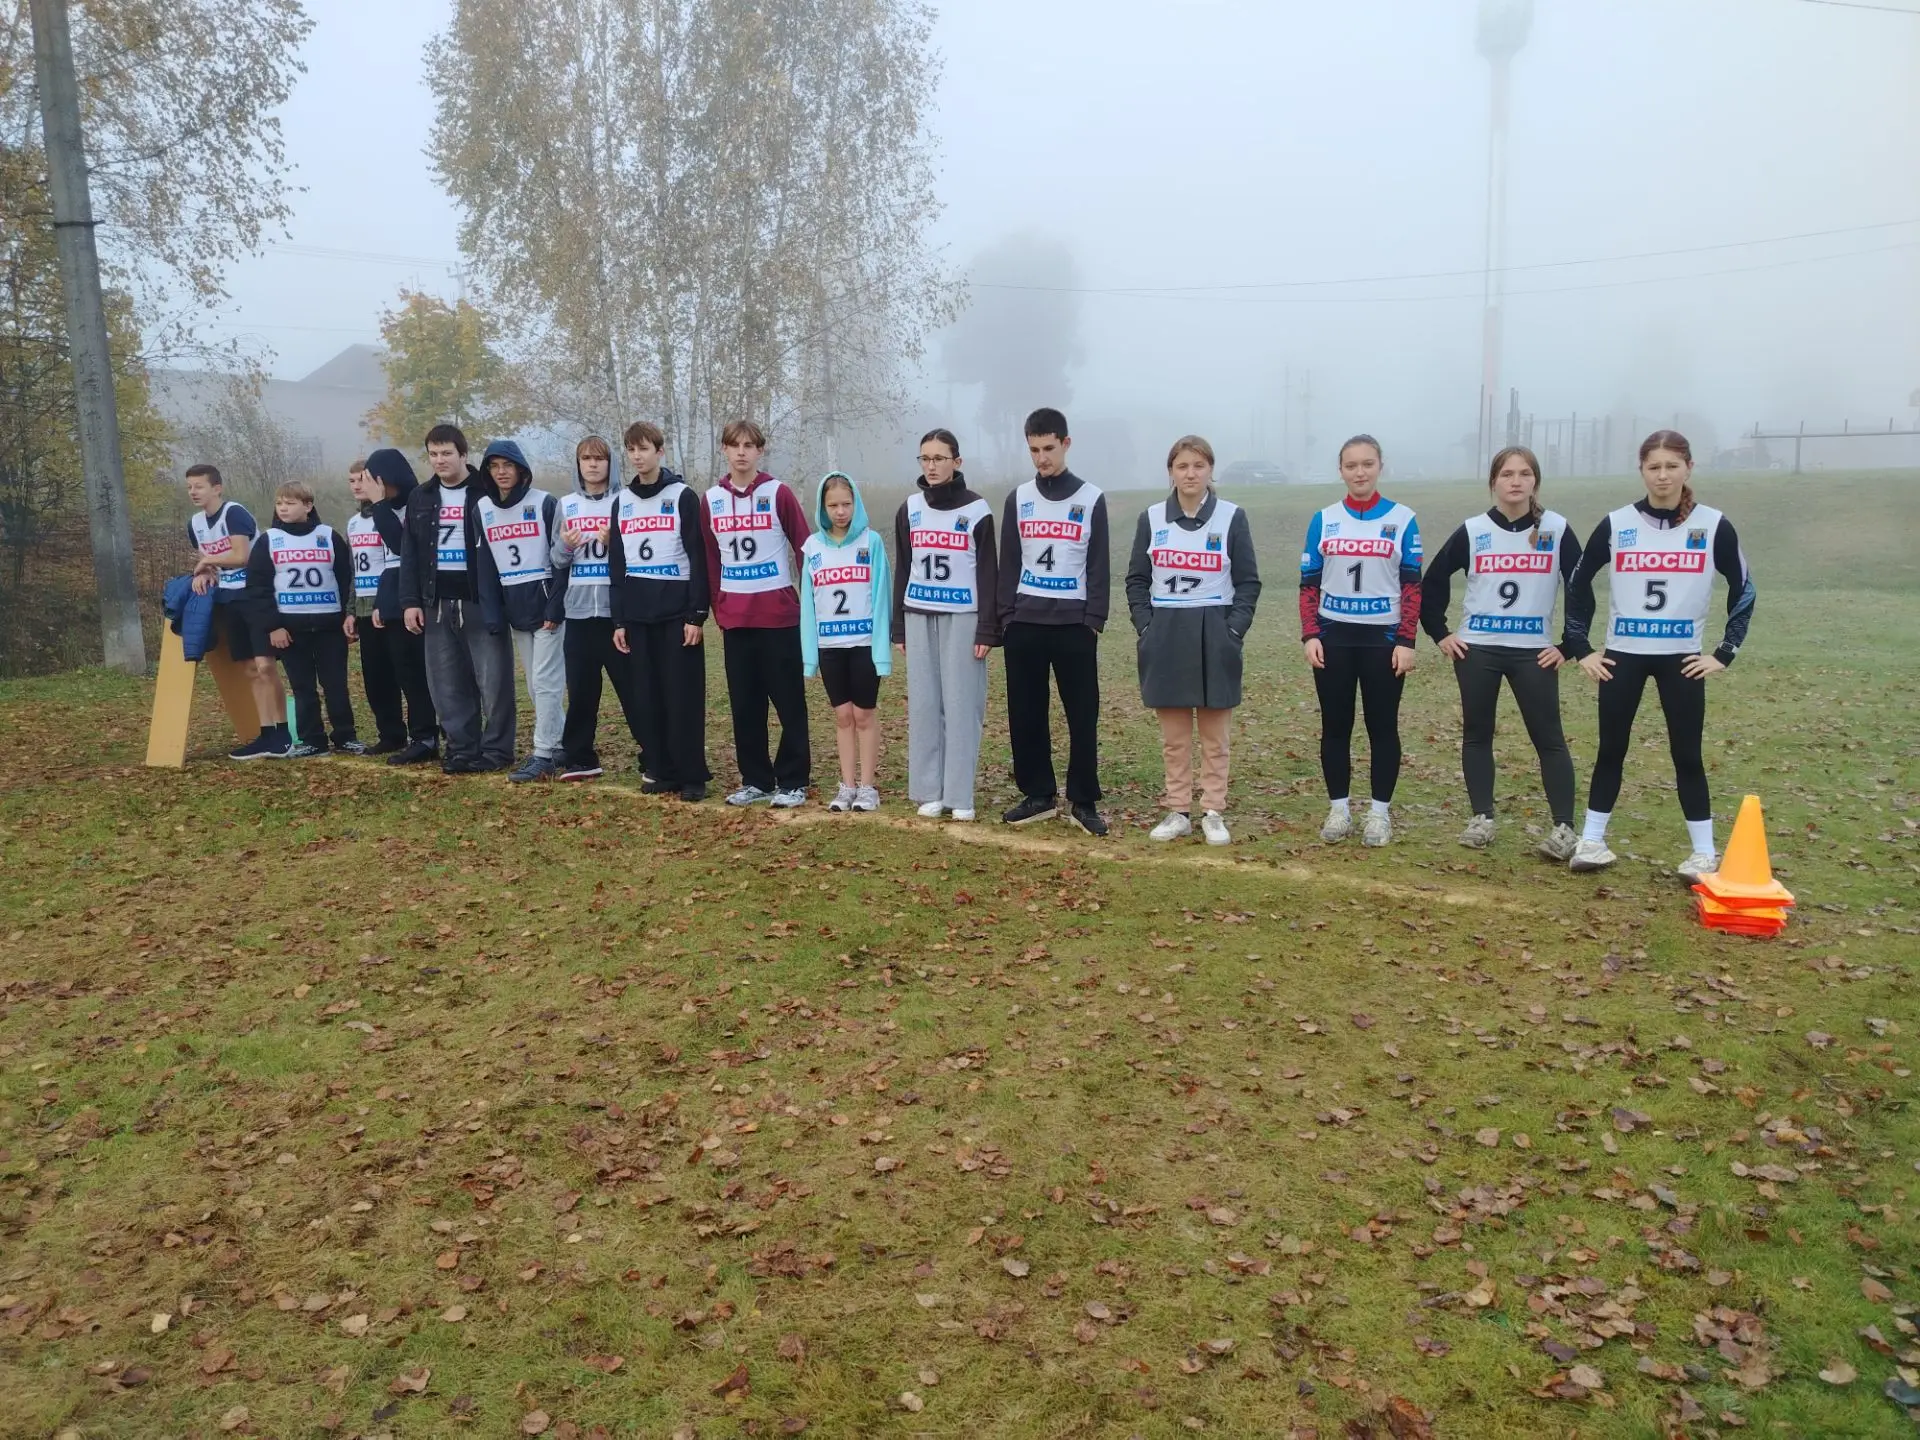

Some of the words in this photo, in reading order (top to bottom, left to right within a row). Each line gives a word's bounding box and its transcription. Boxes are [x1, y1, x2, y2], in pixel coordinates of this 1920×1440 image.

[490, 523, 535, 541] ДЮСШ
[625, 516, 671, 533] ДЮСШ
[717, 514, 768, 532] ДЮСШ
[1023, 521, 1078, 538] ДЮСШ
[439, 525, 456, 545] 7
[912, 531, 965, 547] ДЮСШ
[277, 550, 329, 563] ДЮСШ
[508, 544, 521, 566] 3
[584, 539, 608, 558] 10
[639, 538, 653, 560] 6
[729, 536, 757, 560] 19
[1326, 539, 1391, 556] ДЮСШ
[354, 552, 370, 573] 18
[920, 553, 950, 581] 15
[1036, 545, 1055, 571] 4
[1156, 551, 1217, 568] ДЮСШ
[1480, 555, 1548, 572] ДЮСШ
[1621, 553, 1700, 571] ДЮСШ
[287, 567, 323, 588] 20
[816, 567, 867, 585] ДЮСШ
[1164, 575, 1202, 593] 17
[1347, 562, 1363, 592] 1
[280, 594, 336, 603] ДЕМЯНСК
[833, 589, 850, 615] 2
[909, 587, 970, 601] ДЕМЯНСК
[1498, 581, 1519, 609] 9
[1644, 580, 1668, 612] 5
[1324, 597, 1390, 611] ДЕМЯНСК
[1471, 617, 1542, 631] ДЕМЯНСК
[1617, 621, 1694, 635] ДЕМЯНСК
